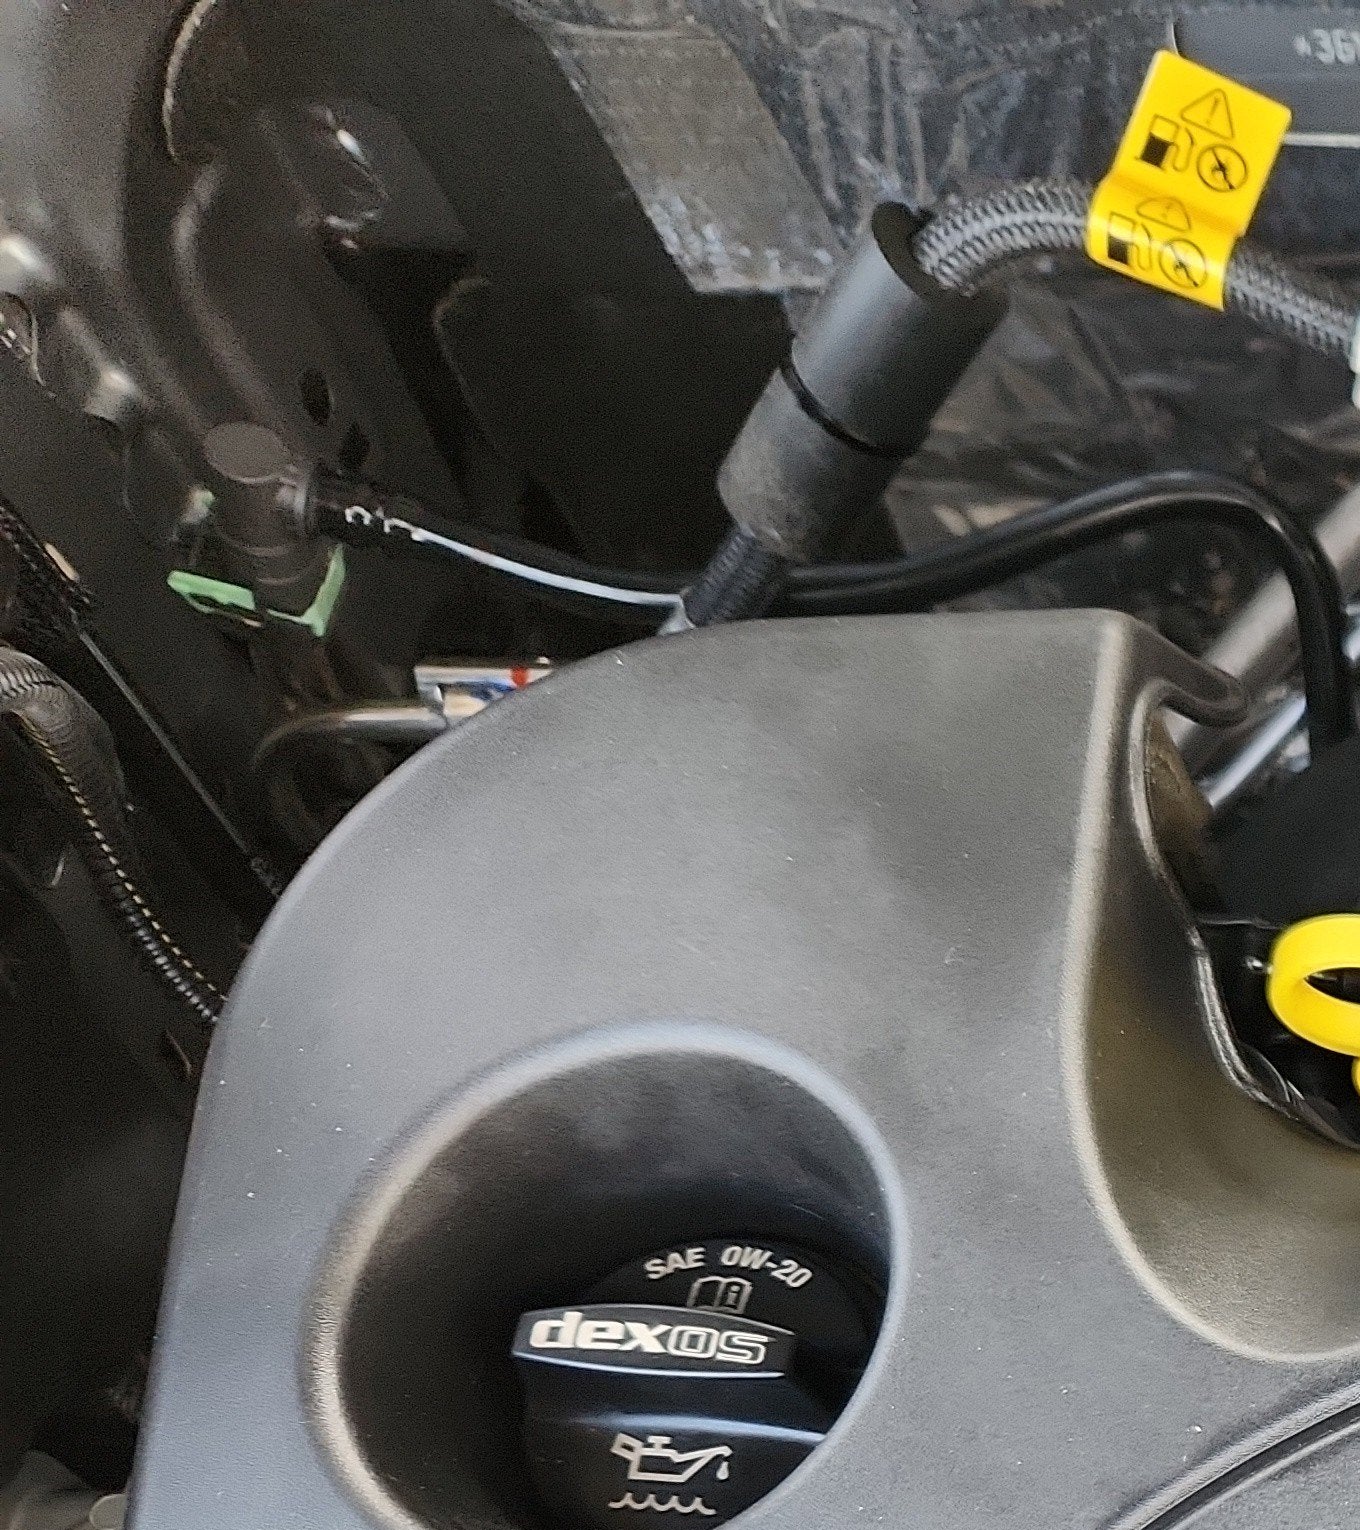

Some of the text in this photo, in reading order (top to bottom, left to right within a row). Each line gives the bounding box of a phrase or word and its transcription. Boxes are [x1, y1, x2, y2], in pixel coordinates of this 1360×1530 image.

[643, 1245, 814, 1288] SAE 0W-20
[529, 1311, 769, 1365] dexos
